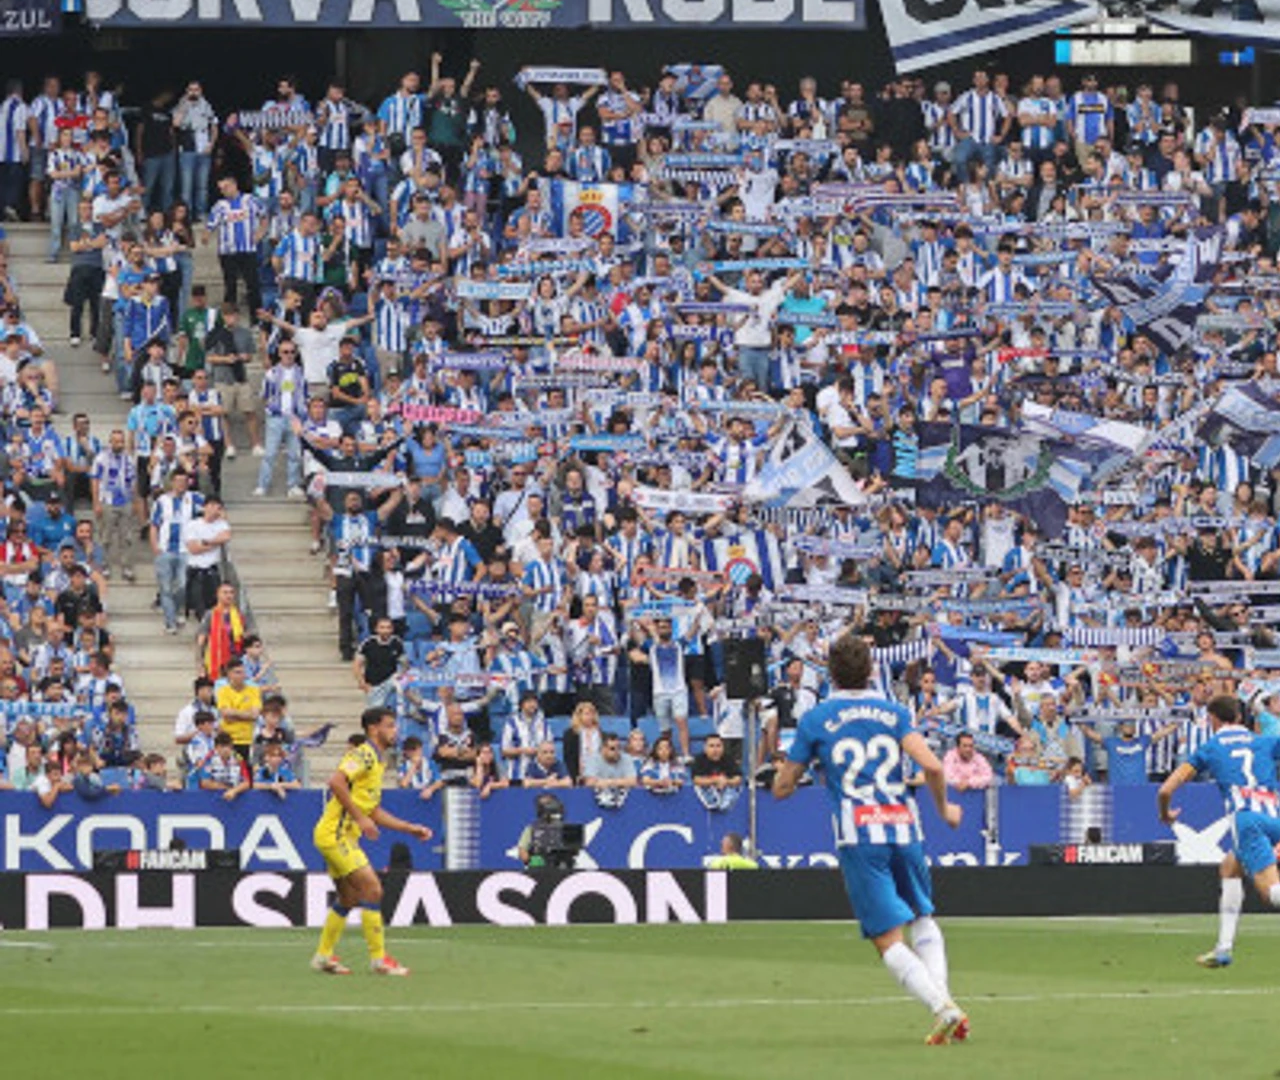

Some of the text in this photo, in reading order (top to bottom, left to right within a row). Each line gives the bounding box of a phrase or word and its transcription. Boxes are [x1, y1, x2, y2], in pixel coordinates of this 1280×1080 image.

[832, 734, 906, 801] 22
[1231, 746, 1258, 788] 7
[1065, 844, 1143, 863] #FANCAM
